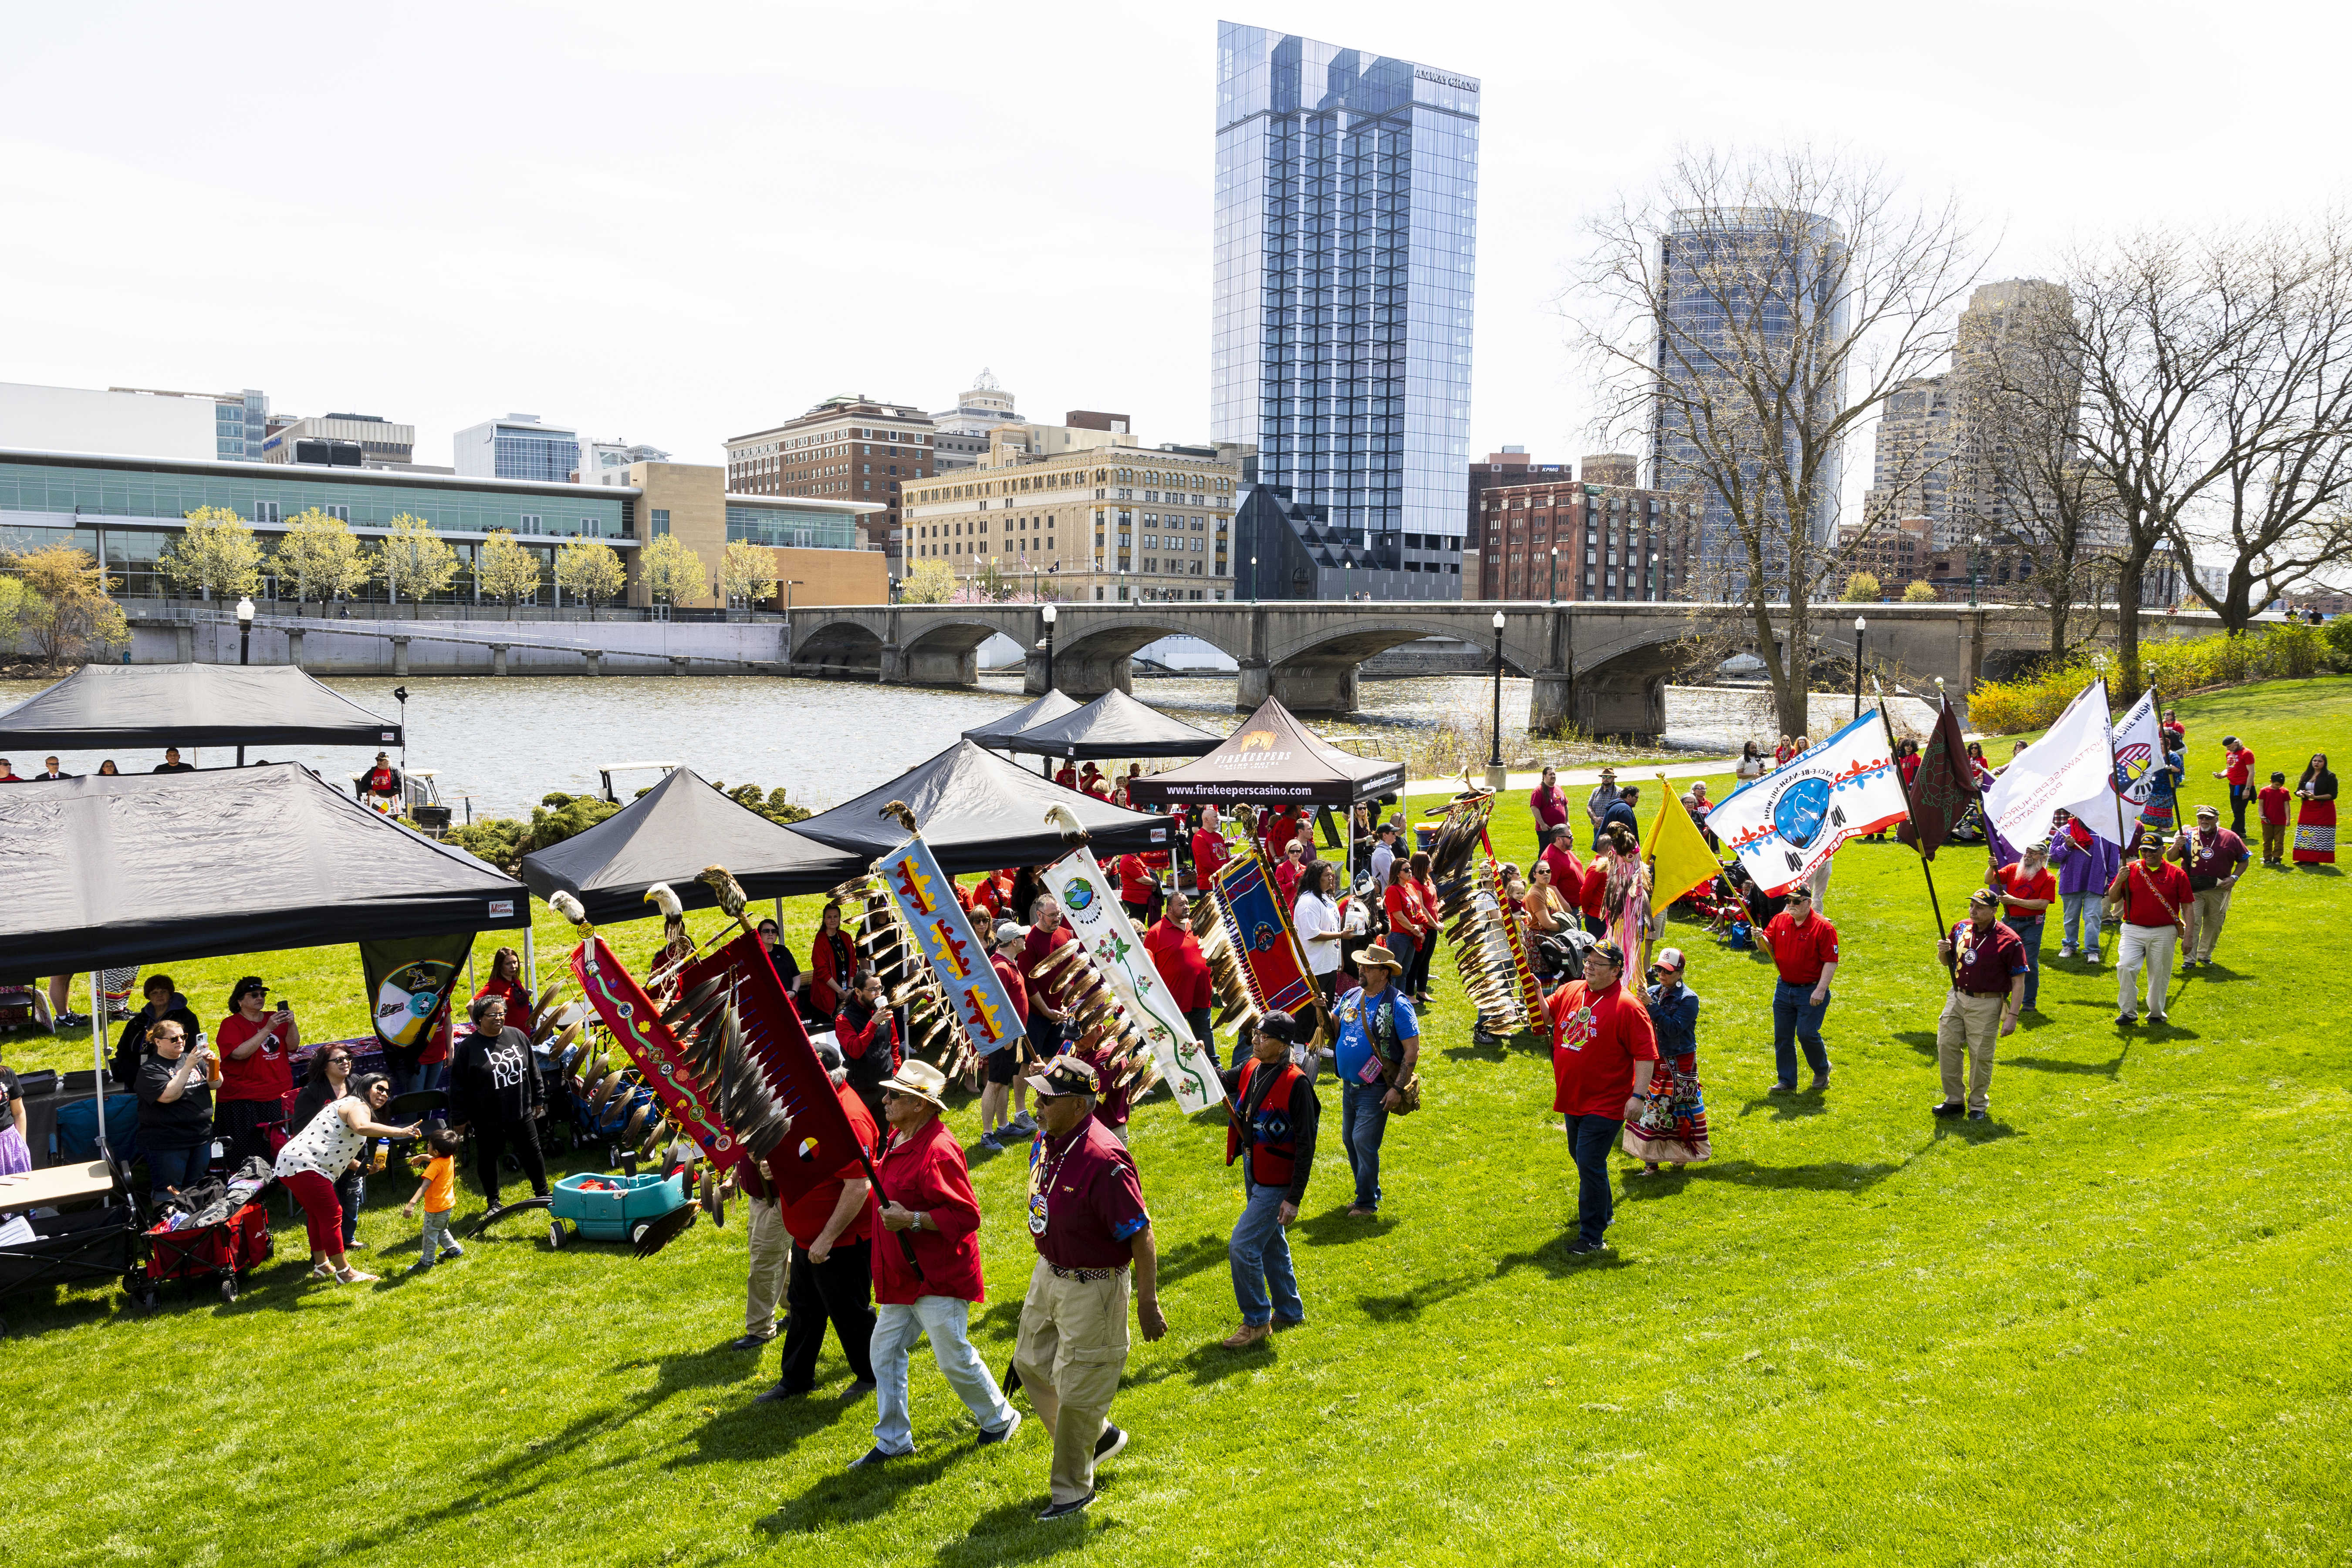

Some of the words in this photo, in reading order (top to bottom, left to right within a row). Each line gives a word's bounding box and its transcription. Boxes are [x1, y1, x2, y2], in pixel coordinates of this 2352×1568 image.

[2118, 720, 2136, 735] SHE
[2132, 703, 2150, 721] WISH
[1213, 751, 1291, 765] FIREKEEPERS
[1167, 784, 1312, 798] www.firekeeperscasino.com
[484, 1044, 524, 1065] bet
[496, 1057, 523, 1075] on
[492, 1068, 527, 1089] her
